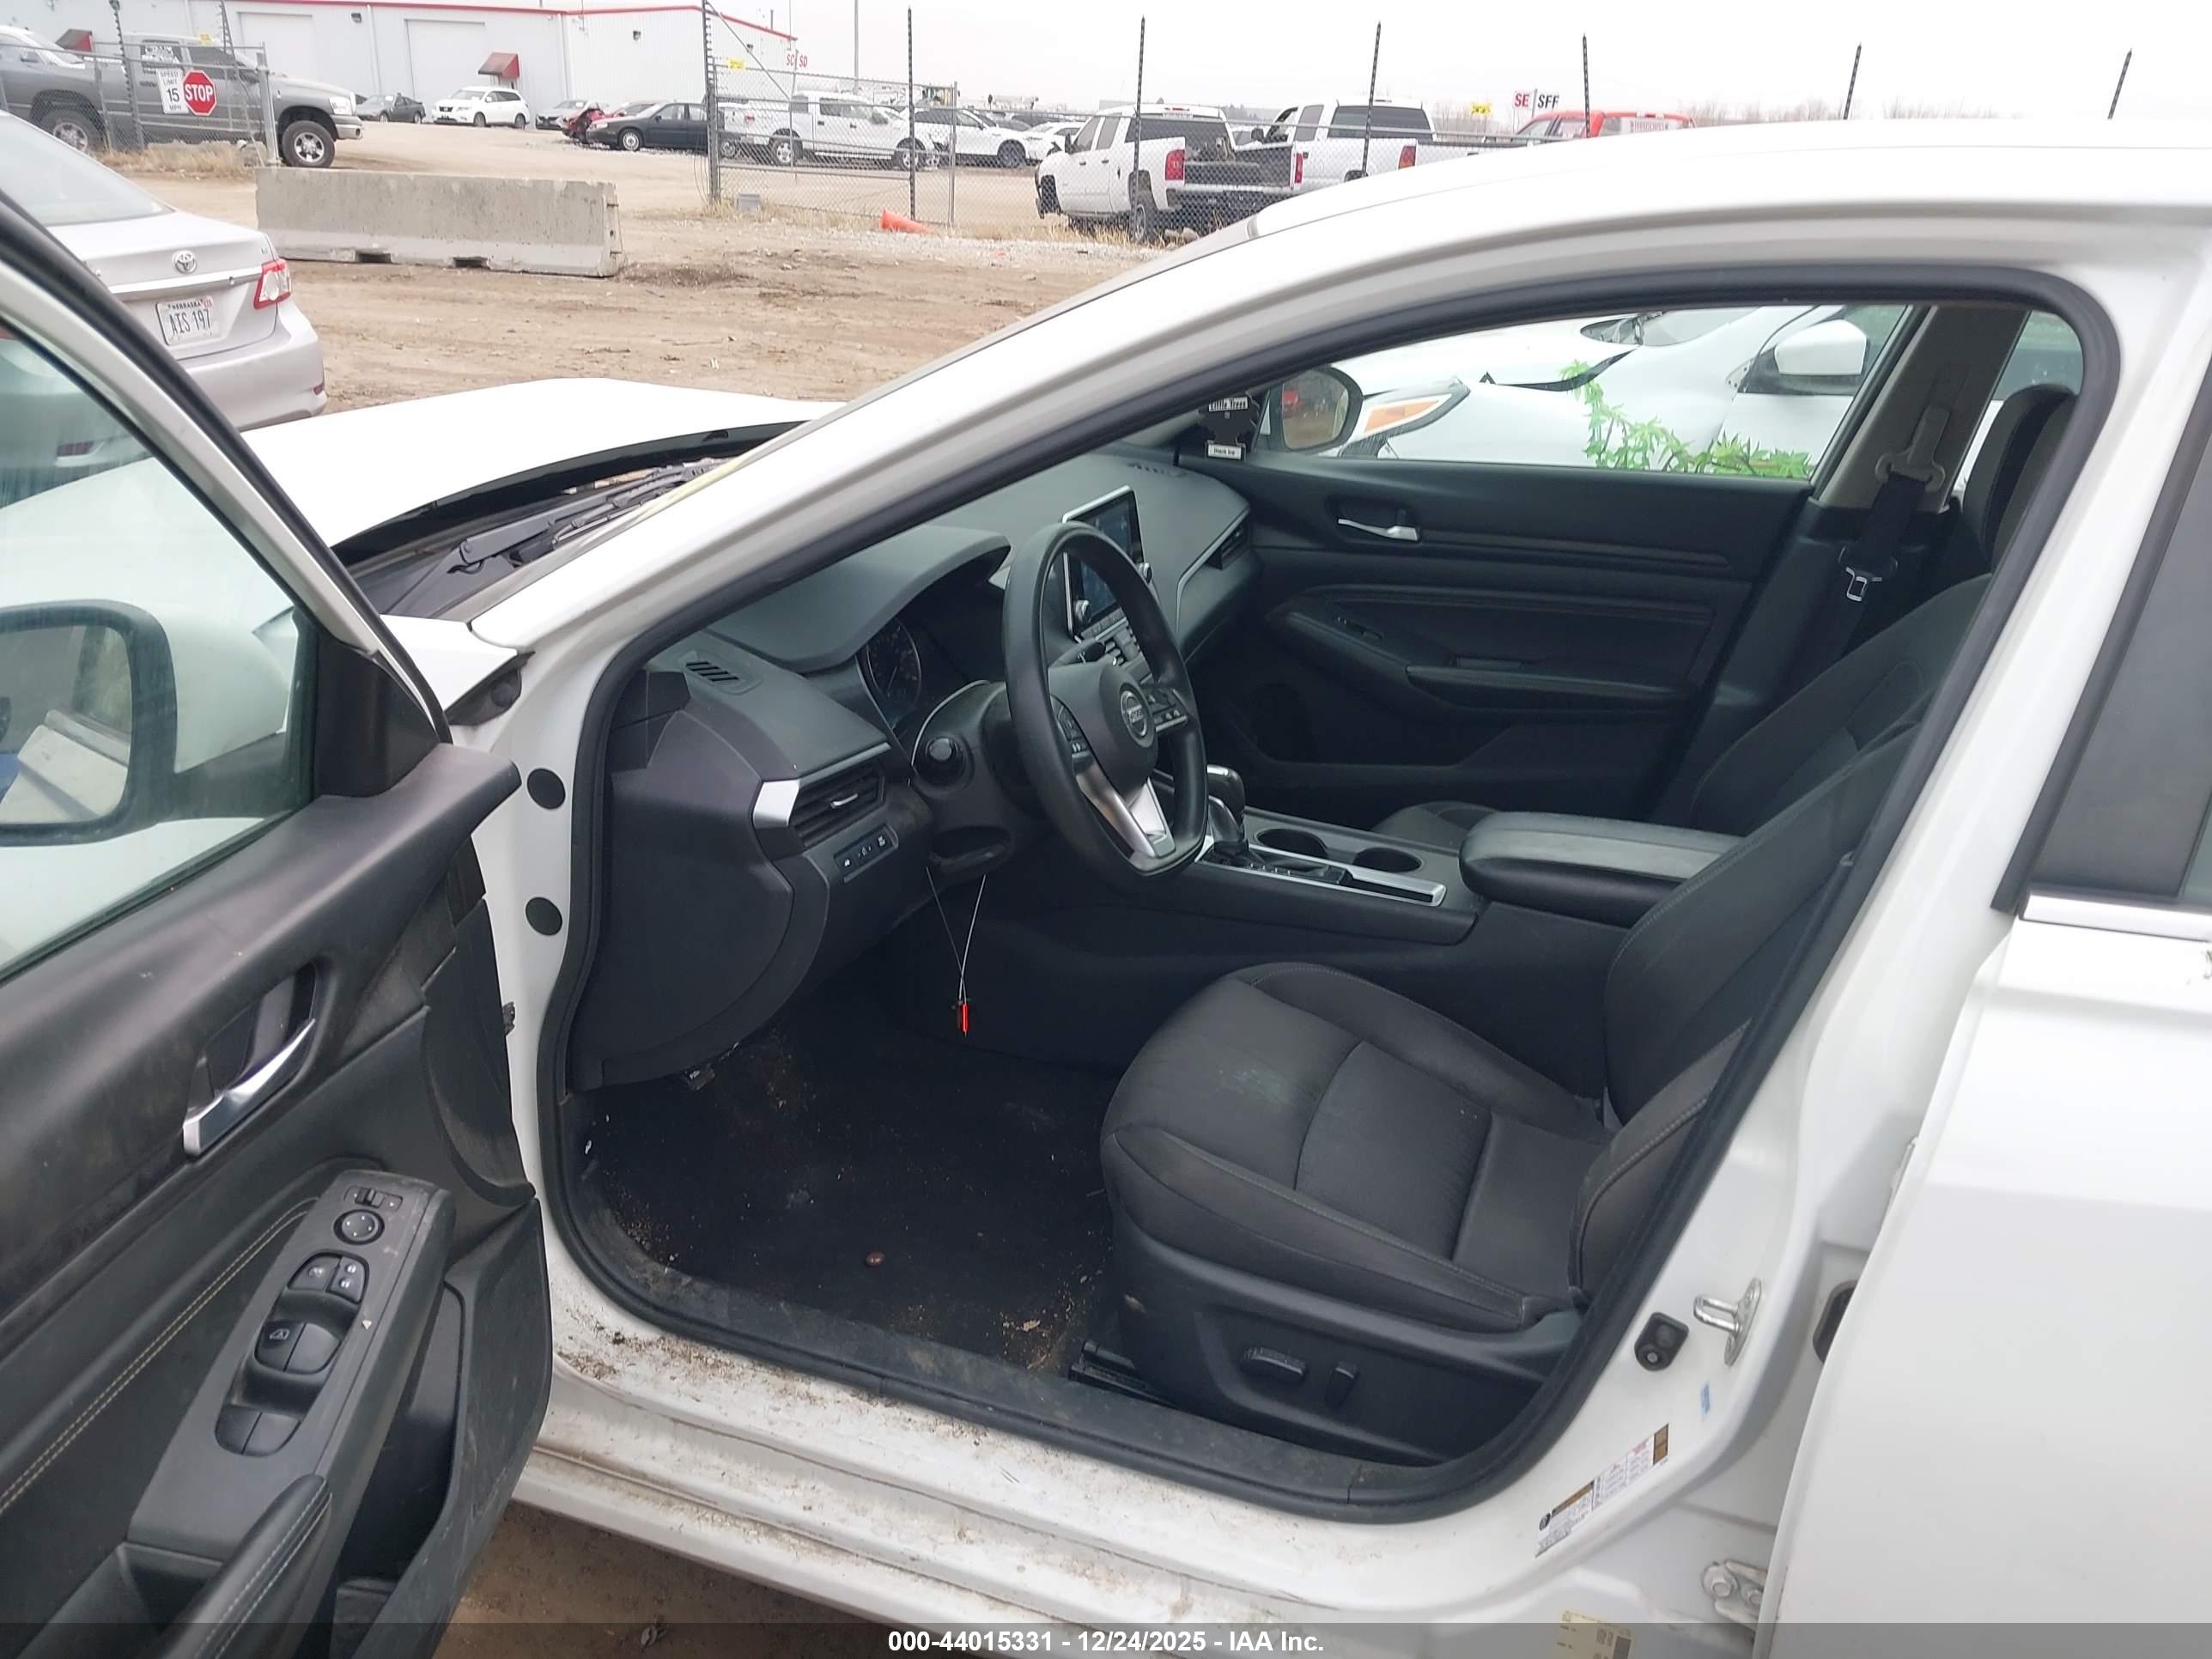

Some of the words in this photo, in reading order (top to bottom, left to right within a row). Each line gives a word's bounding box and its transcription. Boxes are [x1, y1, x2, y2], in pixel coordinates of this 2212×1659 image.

[786, 54, 794, 66] SC
[799, 55, 808, 68] SD
[166, 88, 180, 102] 15
[185, 83, 214, 102] STOP
[1514, 93, 1530, 107] SE
[1537, 94, 1559, 109] SFF
[192, 309, 211, 331] 197
